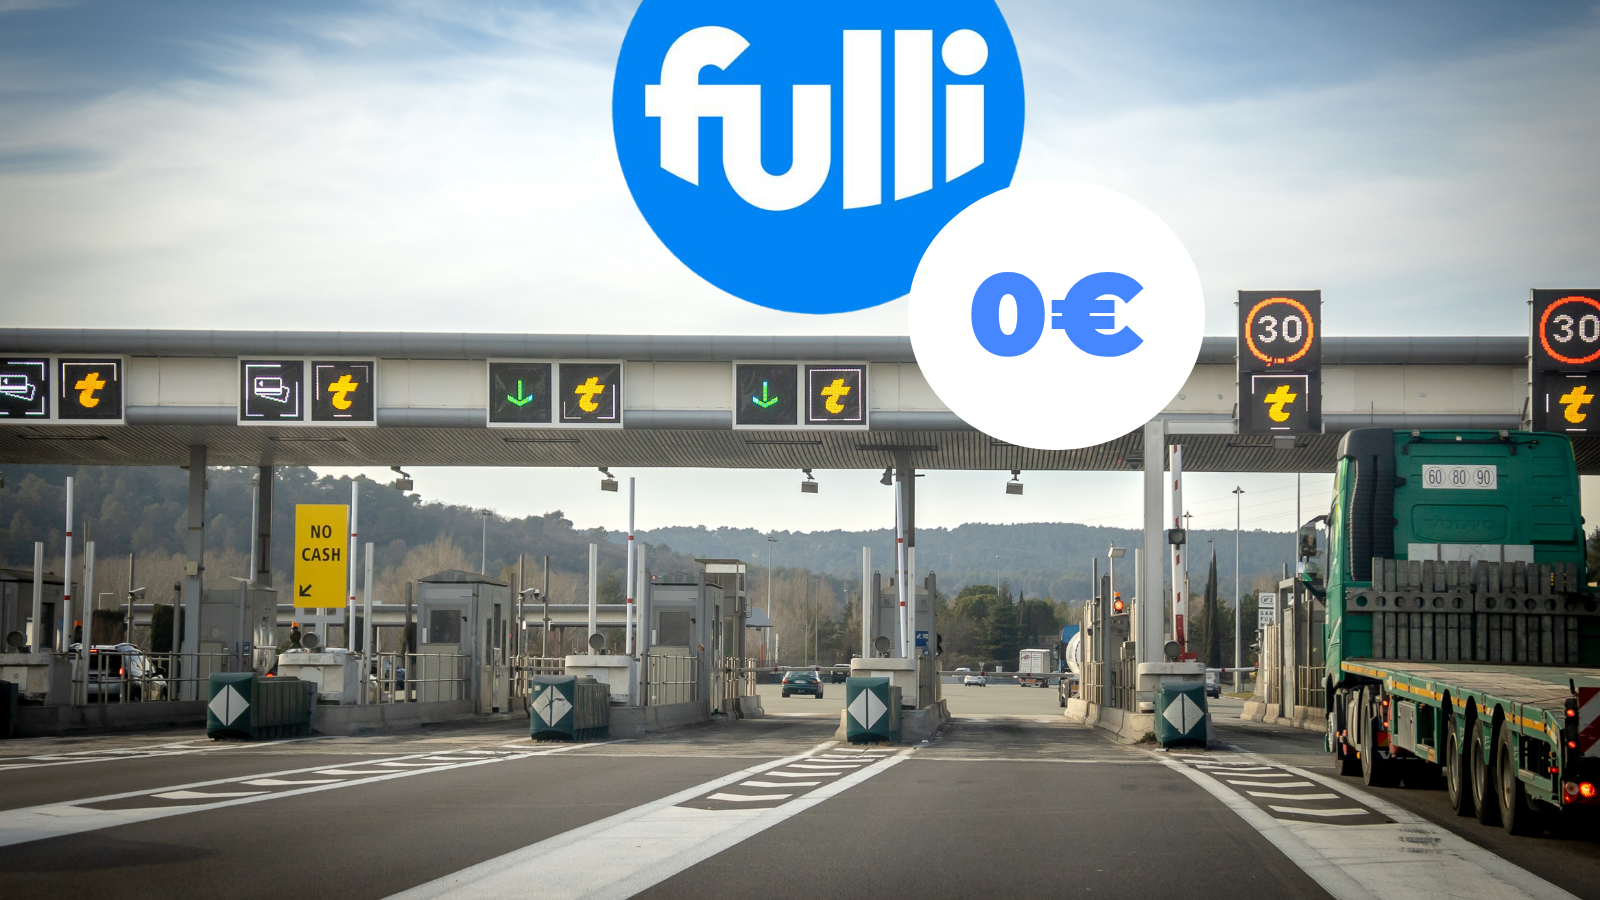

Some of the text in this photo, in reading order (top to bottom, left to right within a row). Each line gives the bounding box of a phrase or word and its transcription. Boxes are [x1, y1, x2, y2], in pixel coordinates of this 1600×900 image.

[1258, 315, 1302, 343] 30
[1553, 314, 1600, 343] 30
[1428, 469, 1490, 485] 60 80 90
[311, 525, 332, 538] NO
[302, 547, 340, 561] CASH
